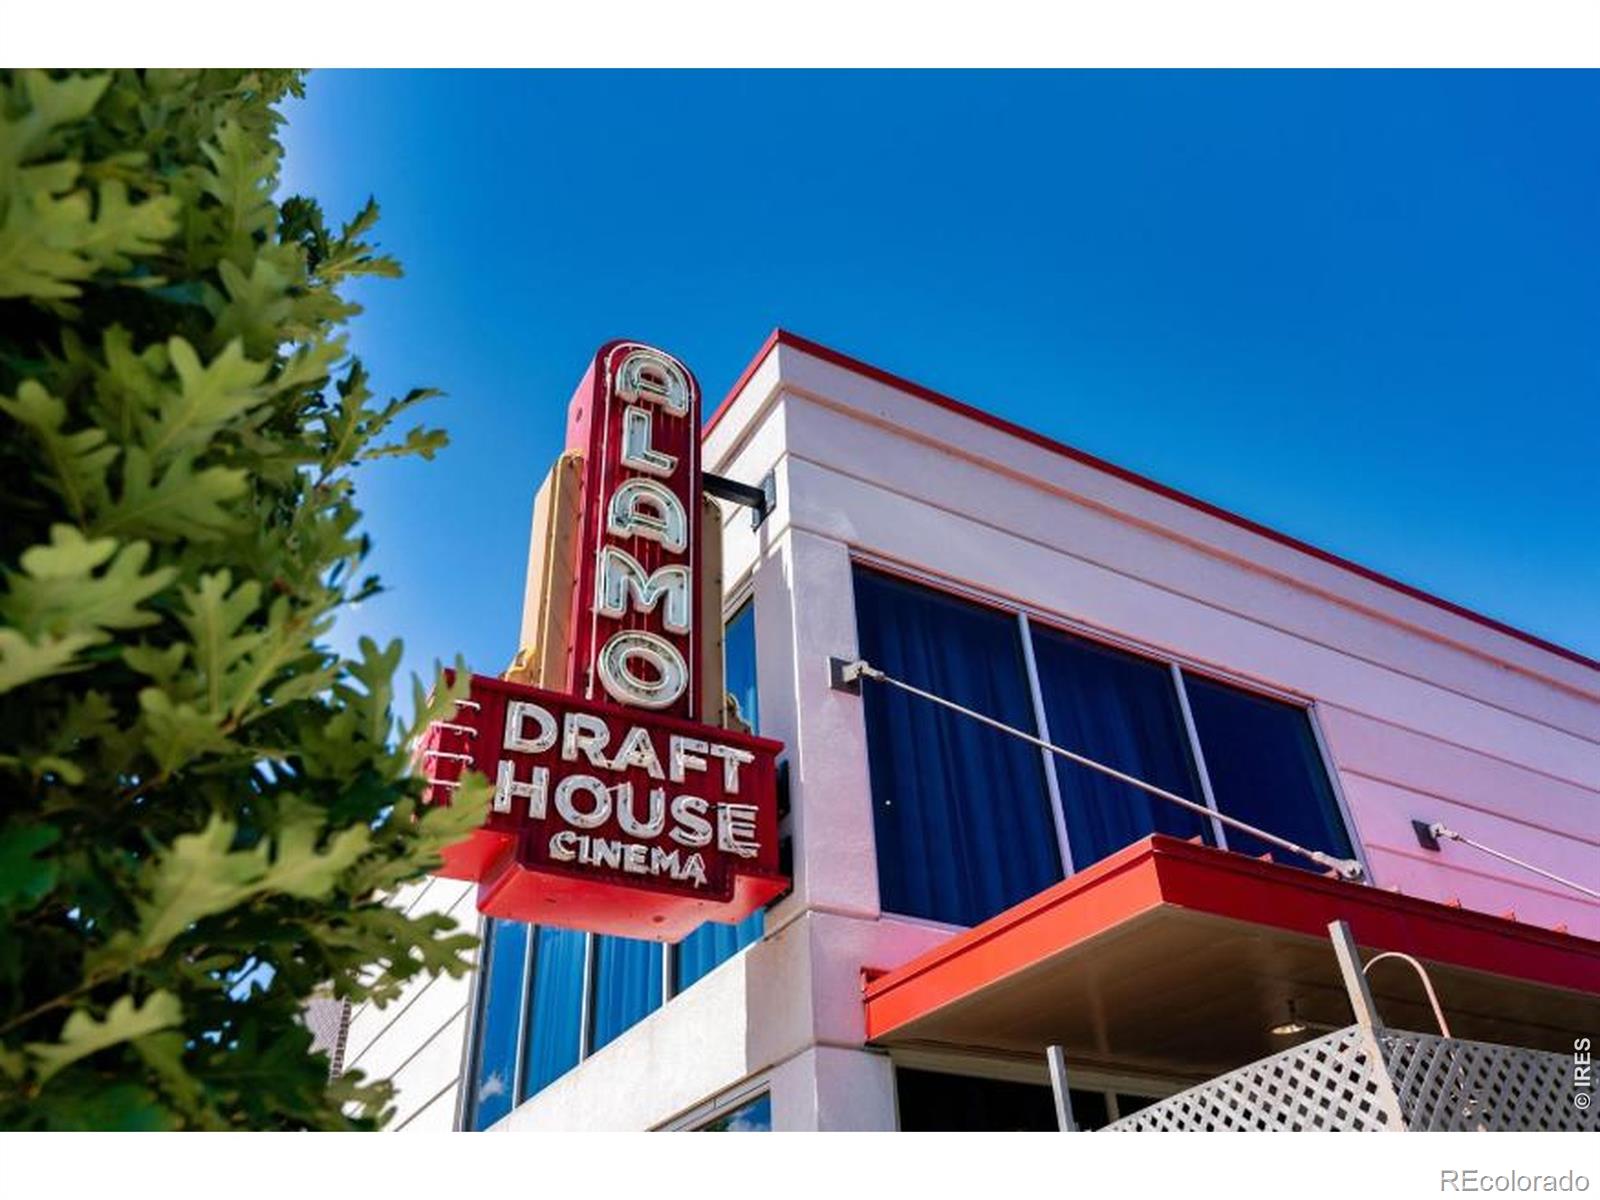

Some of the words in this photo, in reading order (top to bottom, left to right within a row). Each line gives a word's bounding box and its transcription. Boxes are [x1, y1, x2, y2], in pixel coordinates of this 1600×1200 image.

[597, 349, 691, 709] ALAMO
[503, 700, 756, 794] DRAFT
[493, 759, 762, 858] HOUSE
[549, 830, 708, 889] CINEMA
